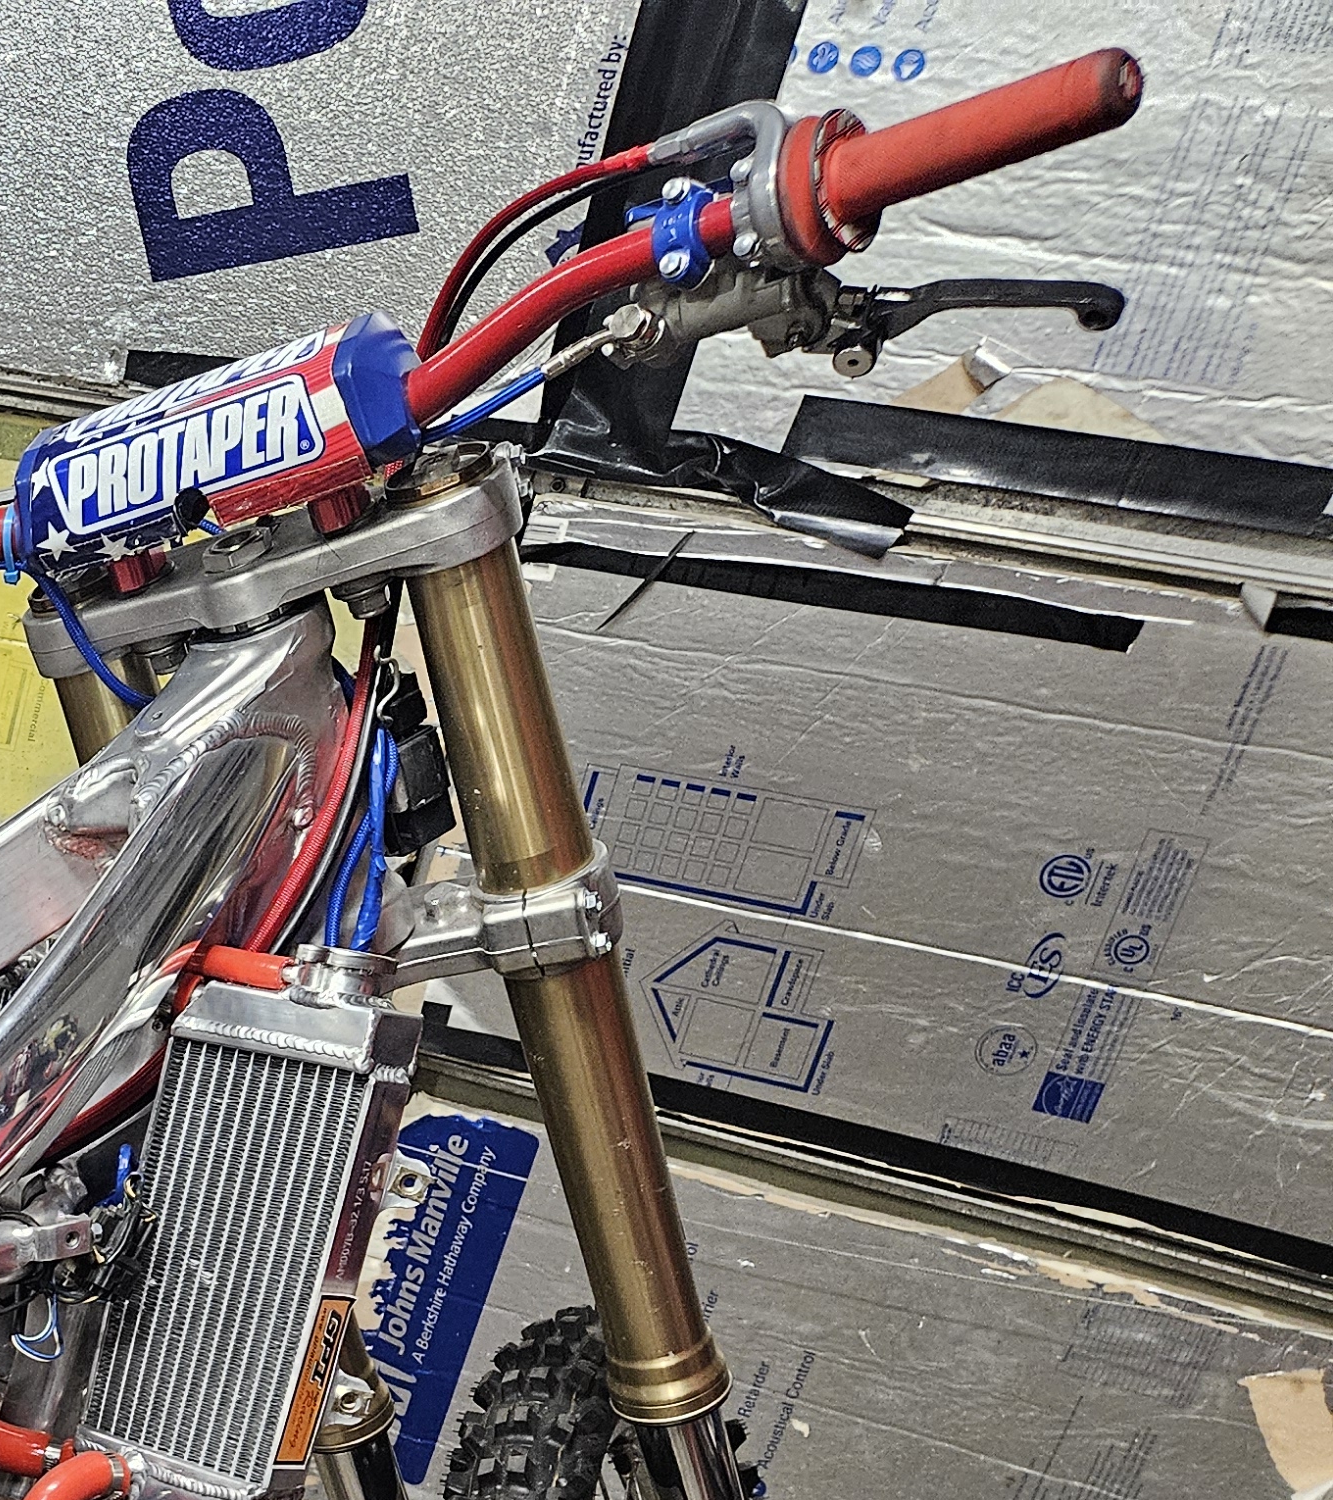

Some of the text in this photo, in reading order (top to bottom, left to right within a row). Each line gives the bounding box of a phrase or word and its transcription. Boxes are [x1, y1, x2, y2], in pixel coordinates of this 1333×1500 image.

[574, 32, 631, 168] nufactured by:
[68, 382, 301, 530] PROTAPER
[824, 818, 852, 876] Below Grade
[809, 891, 826, 919] Under
[1089, 860, 1119, 908] Intertek
[1005, 970, 1025, 994] ICC
[1073, 986, 1099, 1030] Insulate
[989, 1031, 1016, 1068] abaa
[1081, 1009, 1108, 1053] ENERGY
[810, 1049, 835, 1096] Under Slab
[374, 1262, 427, 1356] Johns
[403, 1129, 472, 1264] Manville
[409, 1144, 499, 1365] A Berkshire Hathaway Company
[307, 1309, 343, 1390] GPI
[736, 1359, 772, 1419] Retarder
[755, 1347, 816, 1471] Acoustical Control
